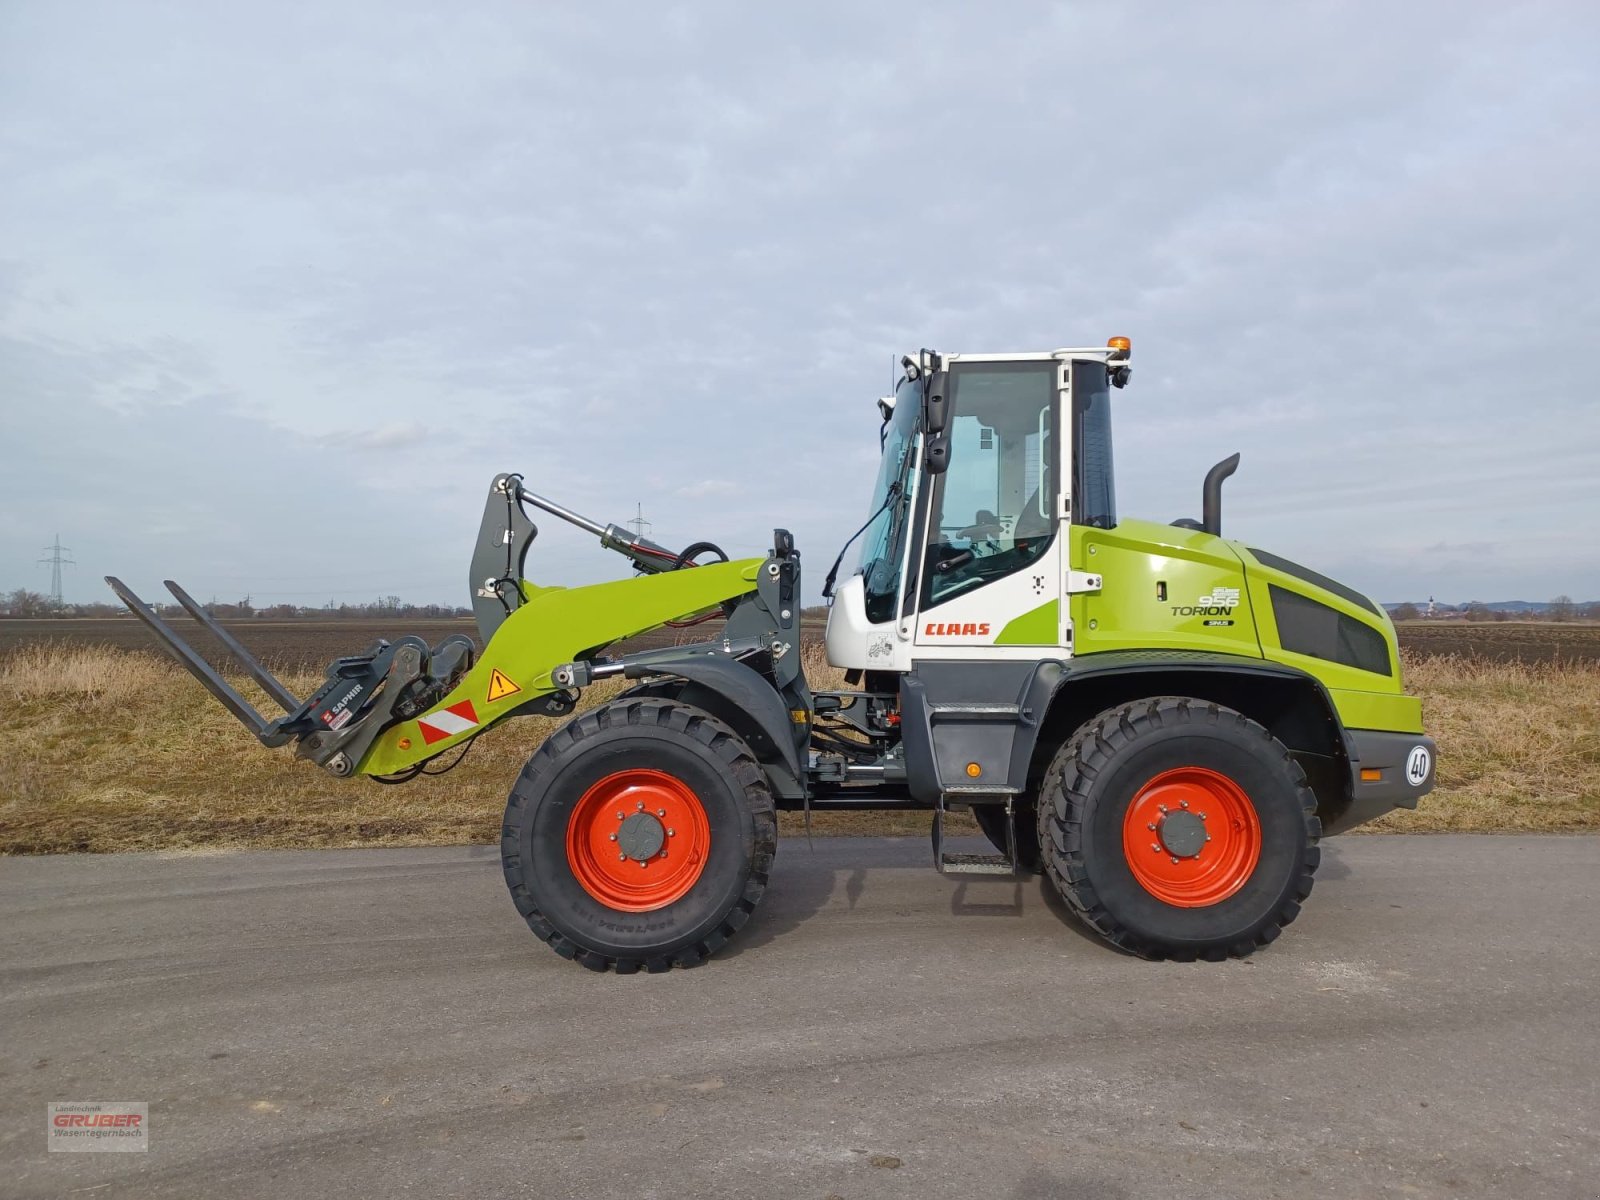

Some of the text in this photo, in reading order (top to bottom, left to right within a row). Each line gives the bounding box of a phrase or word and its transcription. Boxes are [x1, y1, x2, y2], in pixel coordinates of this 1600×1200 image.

[1198, 595, 1240, 607] 956
[1171, 606, 1232, 616] TORION
[925, 623, 990, 635] CLAAS
[332, 684, 364, 714] SAPHIR
[1411, 753, 1426, 778] 40
